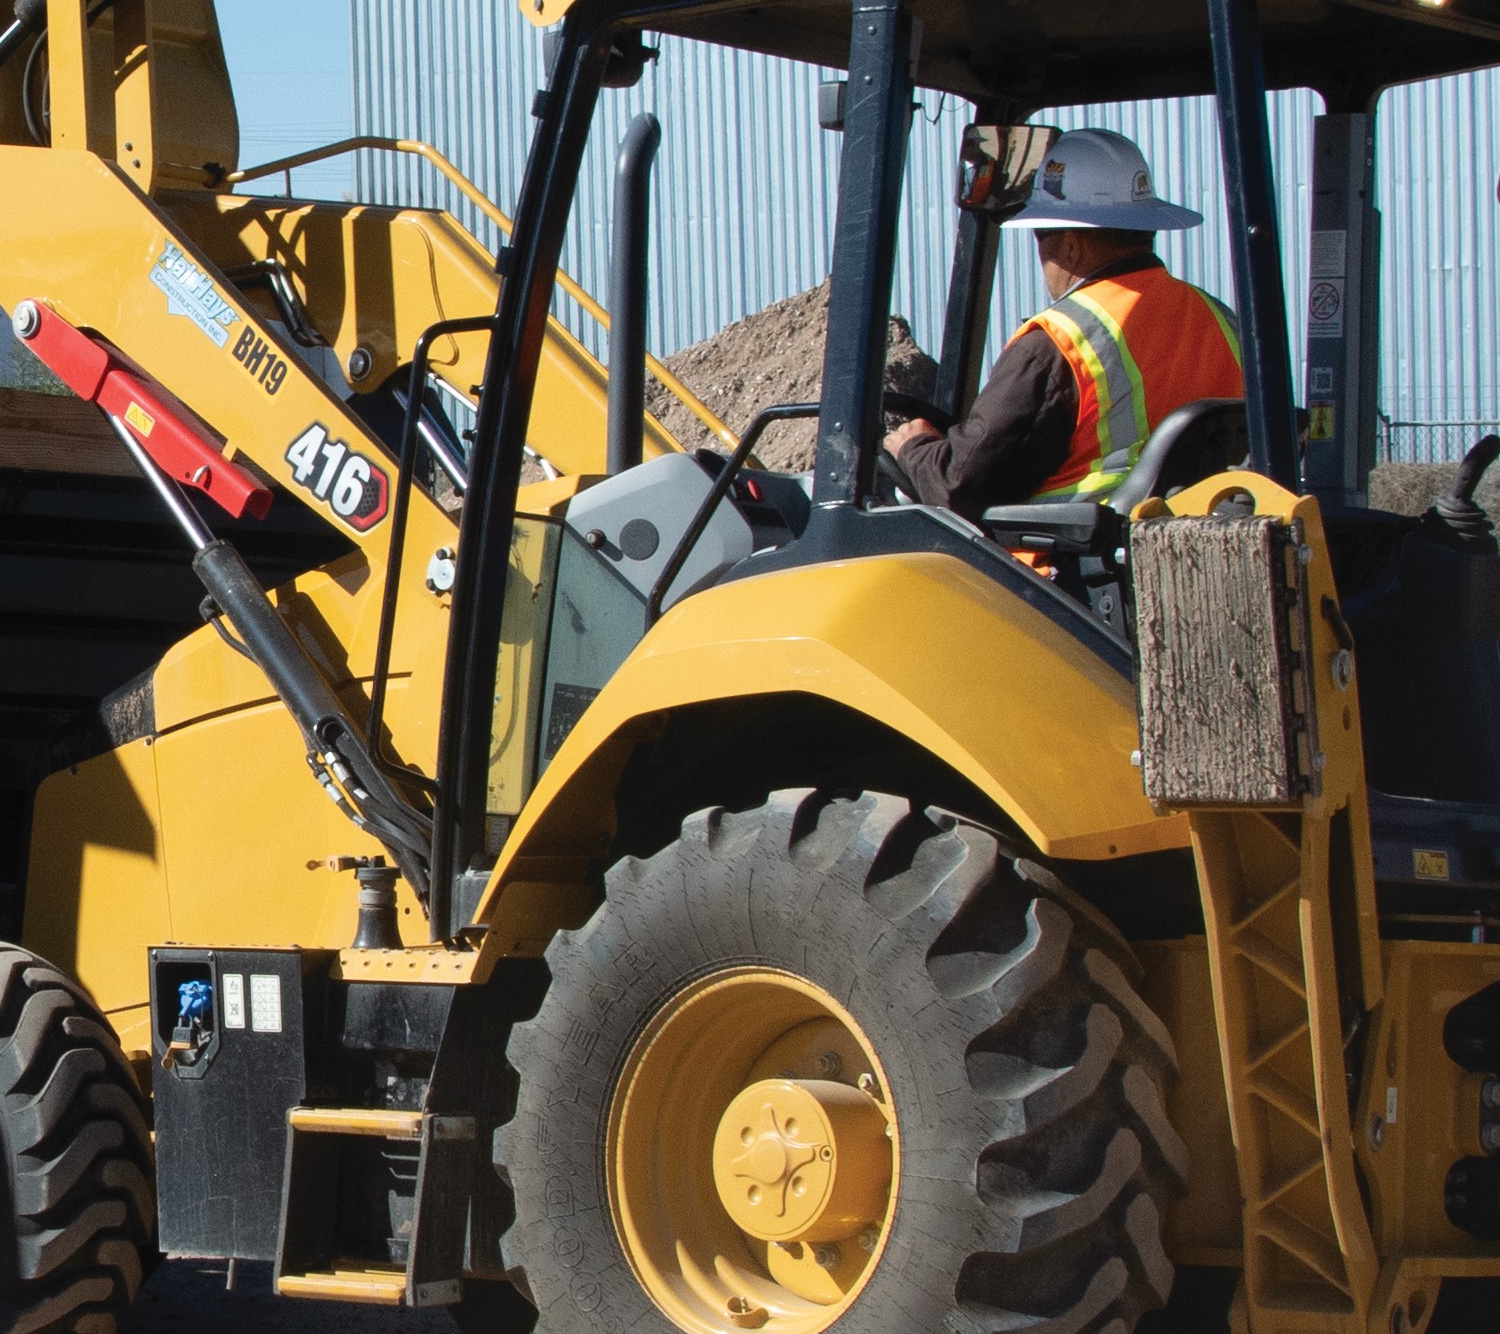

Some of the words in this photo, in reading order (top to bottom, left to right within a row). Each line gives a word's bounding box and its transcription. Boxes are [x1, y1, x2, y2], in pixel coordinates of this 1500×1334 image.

[154, 271, 208, 328] CONSTRUCTION
[157, 242, 198, 284] Hal
[189, 272, 238, 326] Hays
[231, 324, 288, 396] BH19
[286, 424, 371, 516] 416
